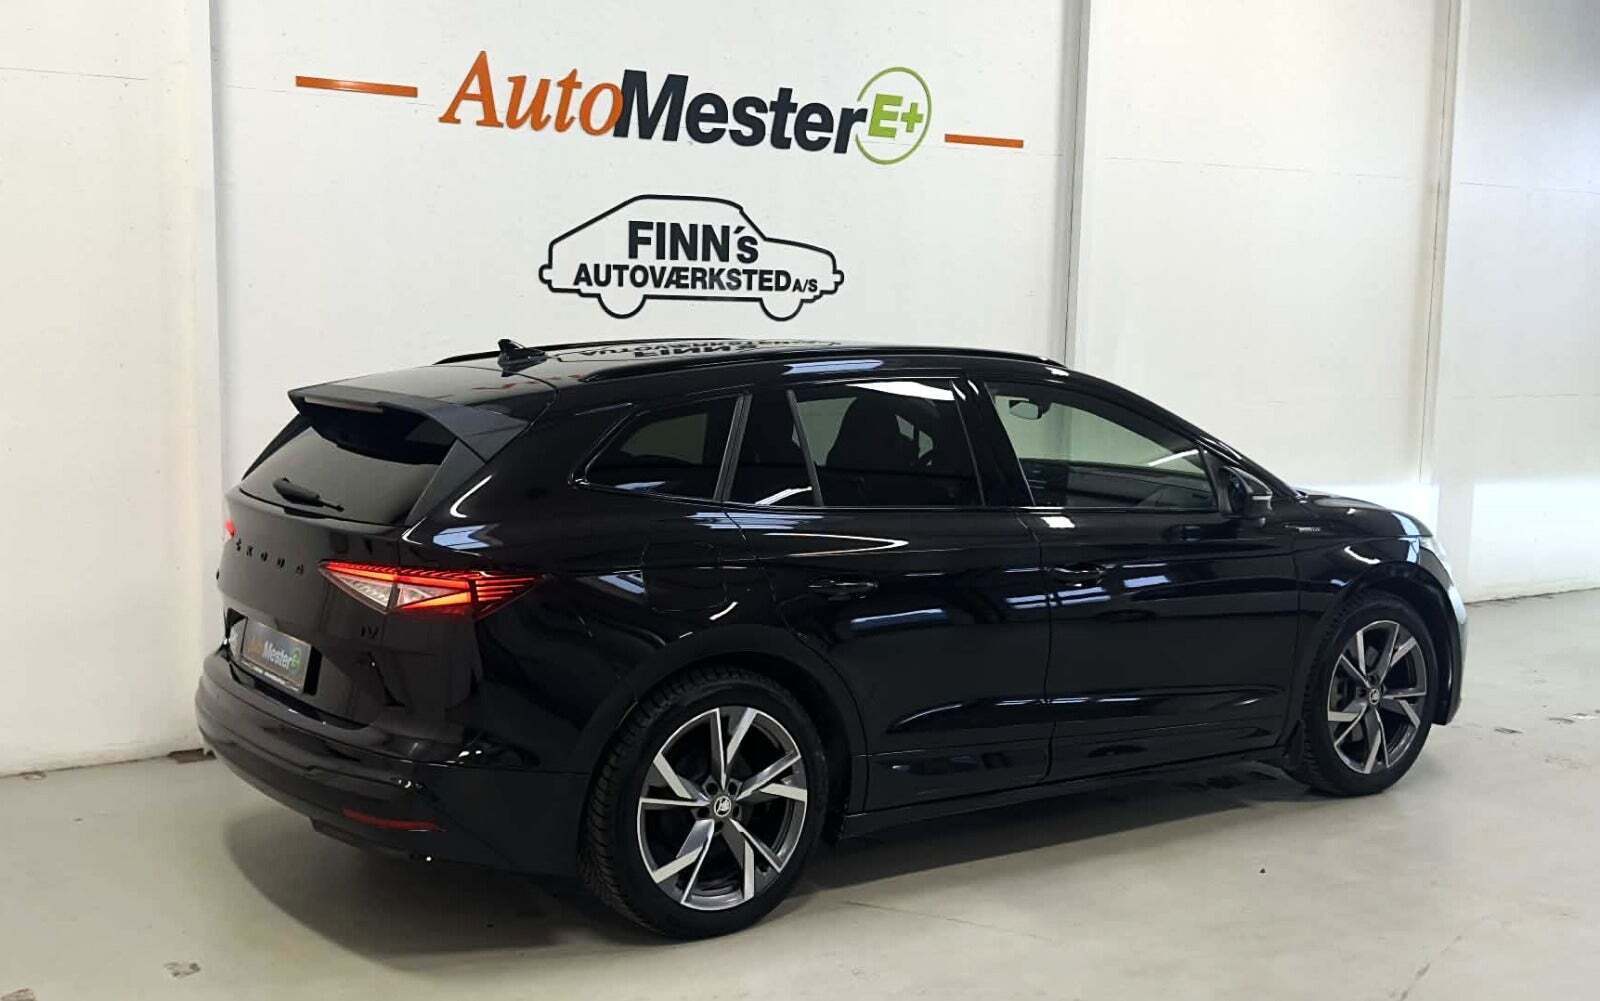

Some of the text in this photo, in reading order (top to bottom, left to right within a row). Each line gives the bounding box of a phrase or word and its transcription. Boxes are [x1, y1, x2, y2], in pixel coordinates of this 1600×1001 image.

[438, 50, 868, 154] AutoMester
[573, 263, 818, 293] AUTOVÆRKSTED A/S
